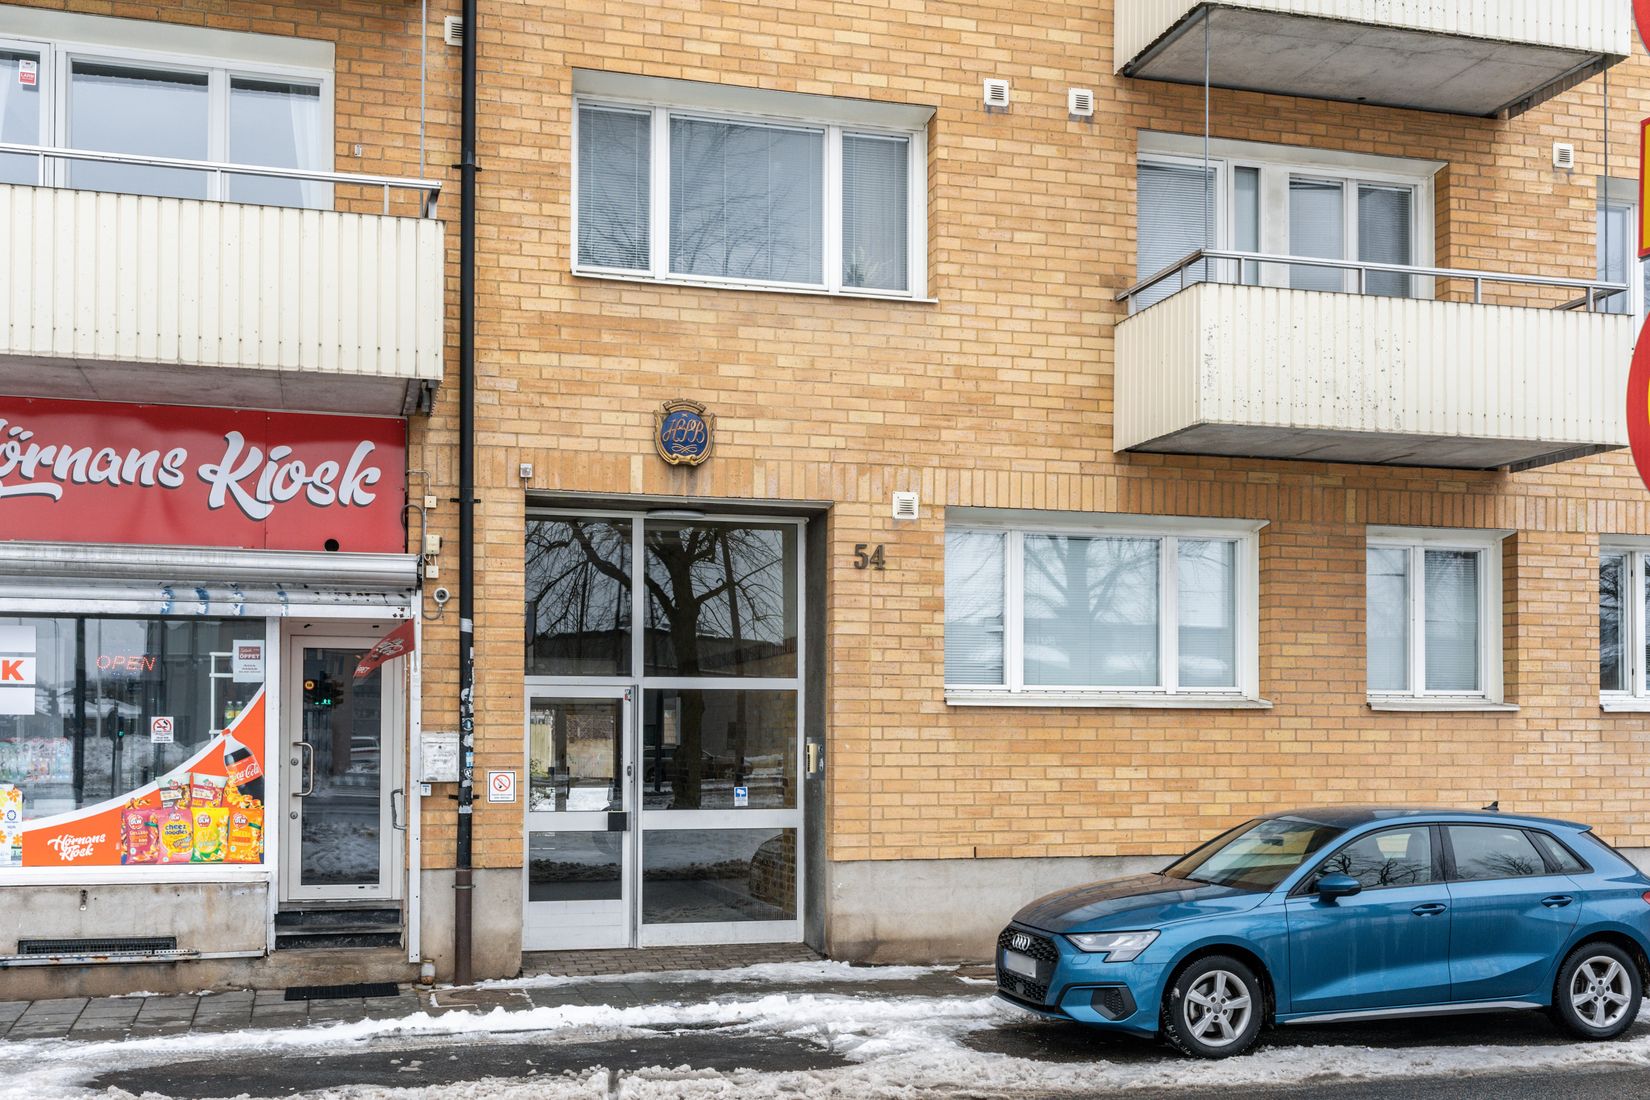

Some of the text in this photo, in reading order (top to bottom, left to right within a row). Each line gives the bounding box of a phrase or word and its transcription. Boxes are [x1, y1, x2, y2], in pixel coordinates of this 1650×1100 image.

[0, 419, 382, 520] örnans Kiosk
[853, 543, 886, 570] 54
[96, 655, 157, 671] OPEN
